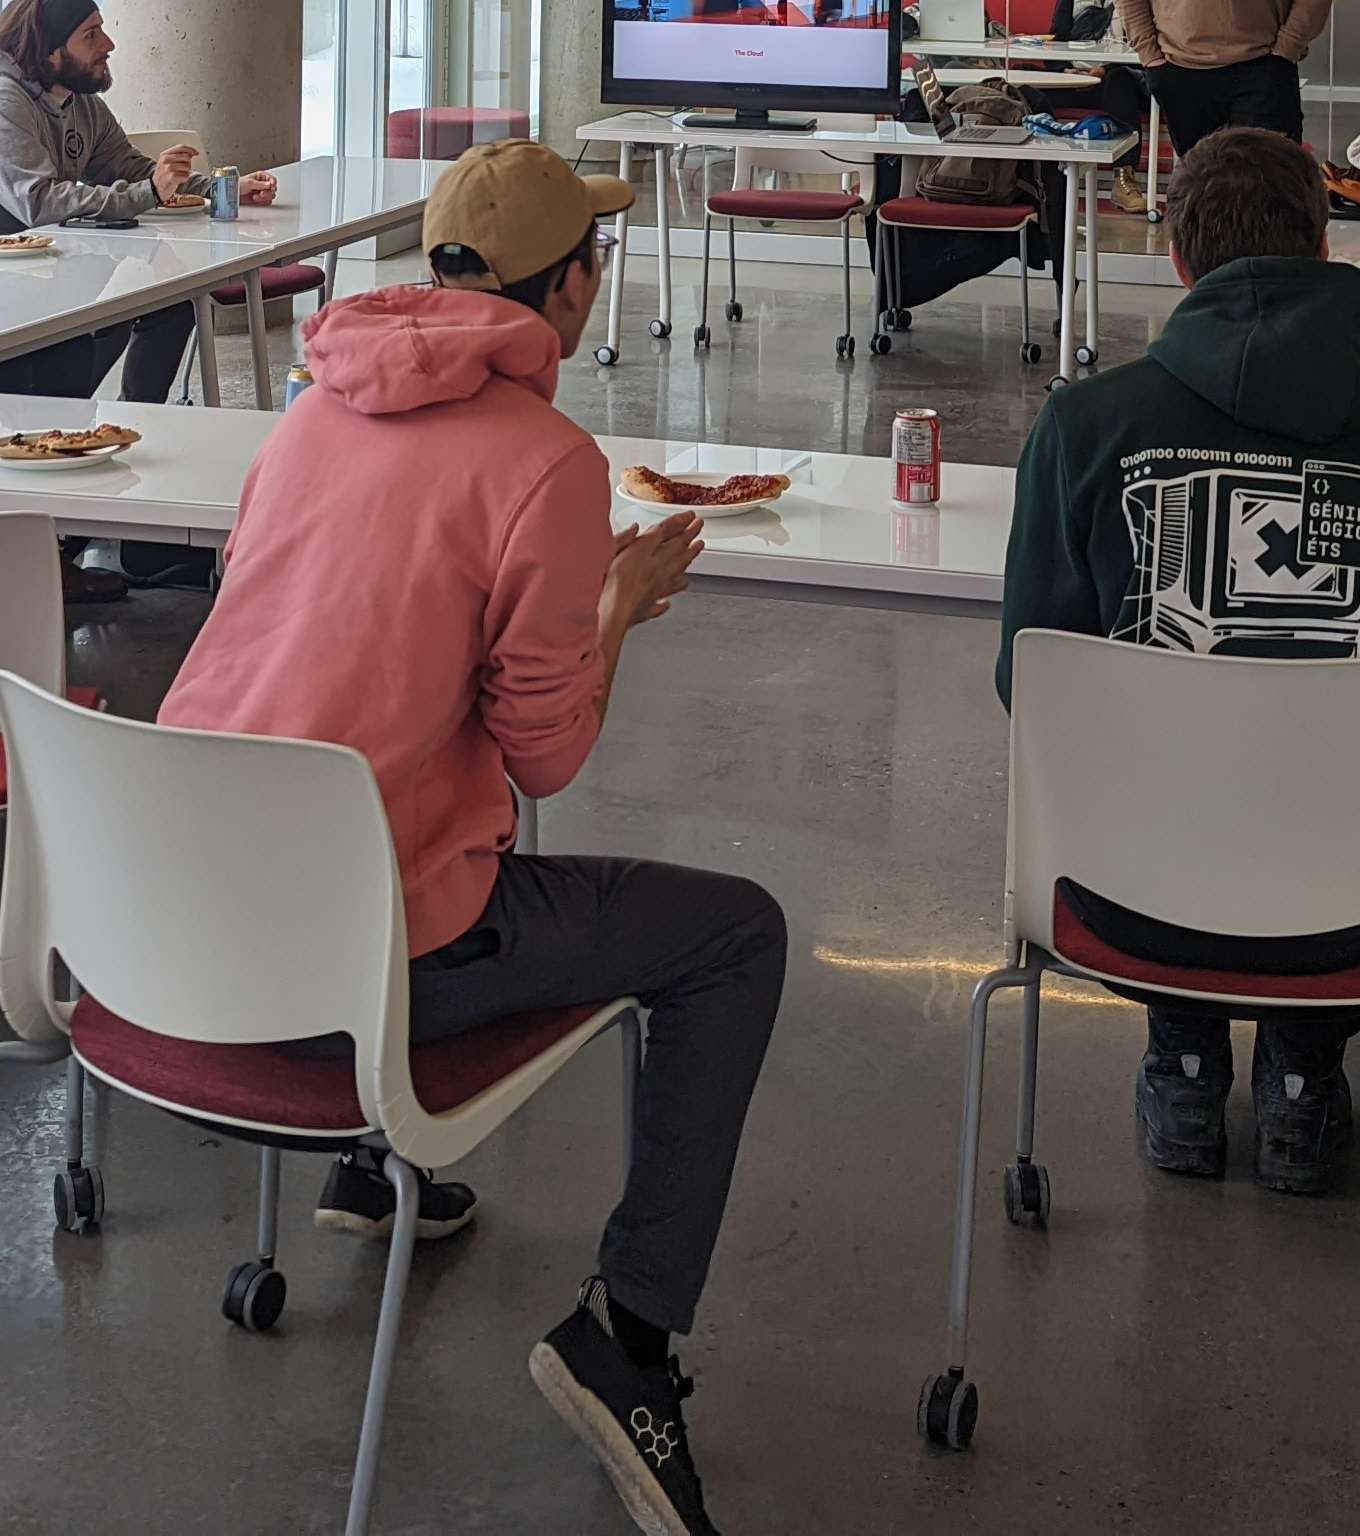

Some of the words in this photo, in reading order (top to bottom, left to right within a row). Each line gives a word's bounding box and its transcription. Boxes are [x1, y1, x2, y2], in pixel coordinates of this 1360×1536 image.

[1119, 448, 1174, 469] 01001100
[1177, 448, 1231, 463] 01001111
[1234, 452, 1293, 468] 01000111
[1306, 539, 1341, 558] ÉTS
